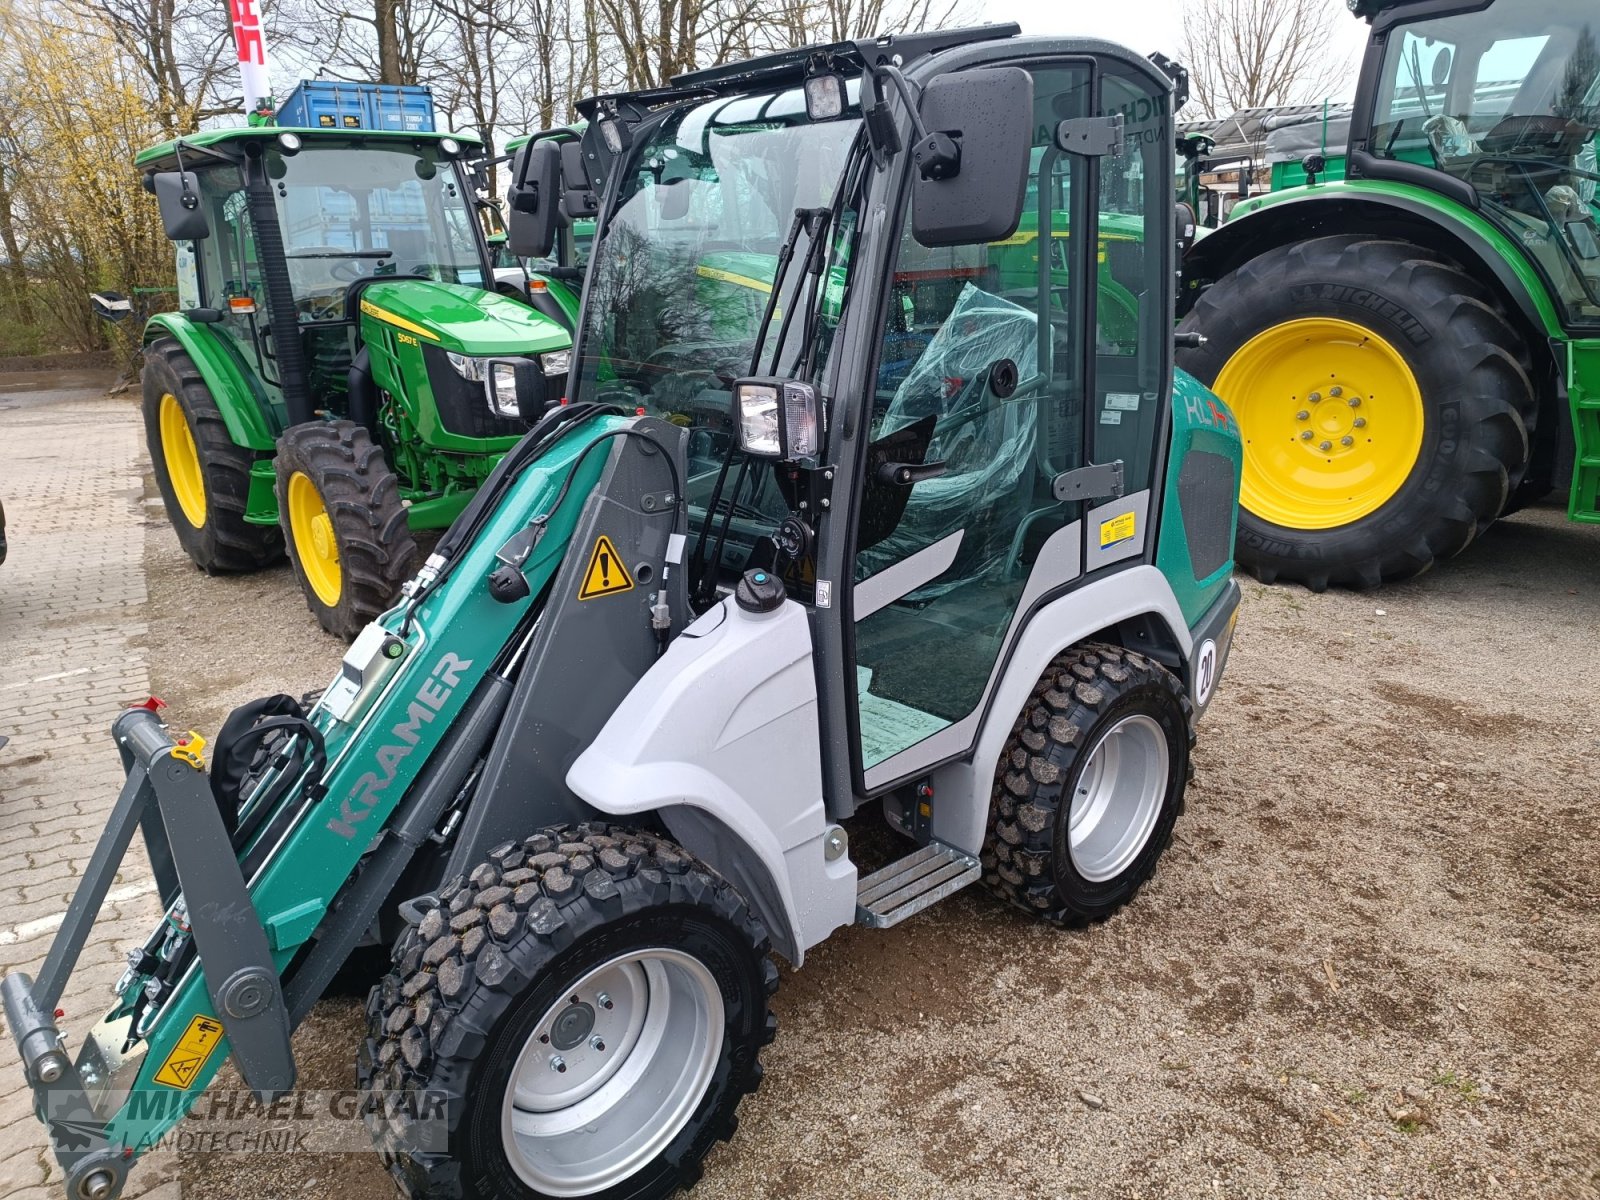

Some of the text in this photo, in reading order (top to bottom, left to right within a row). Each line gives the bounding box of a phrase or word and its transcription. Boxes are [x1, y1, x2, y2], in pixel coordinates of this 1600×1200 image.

[1321, 284, 1432, 346] MICHELIN
[1201, 650, 1213, 697] 20
[326, 652, 474, 840] KRAMER
